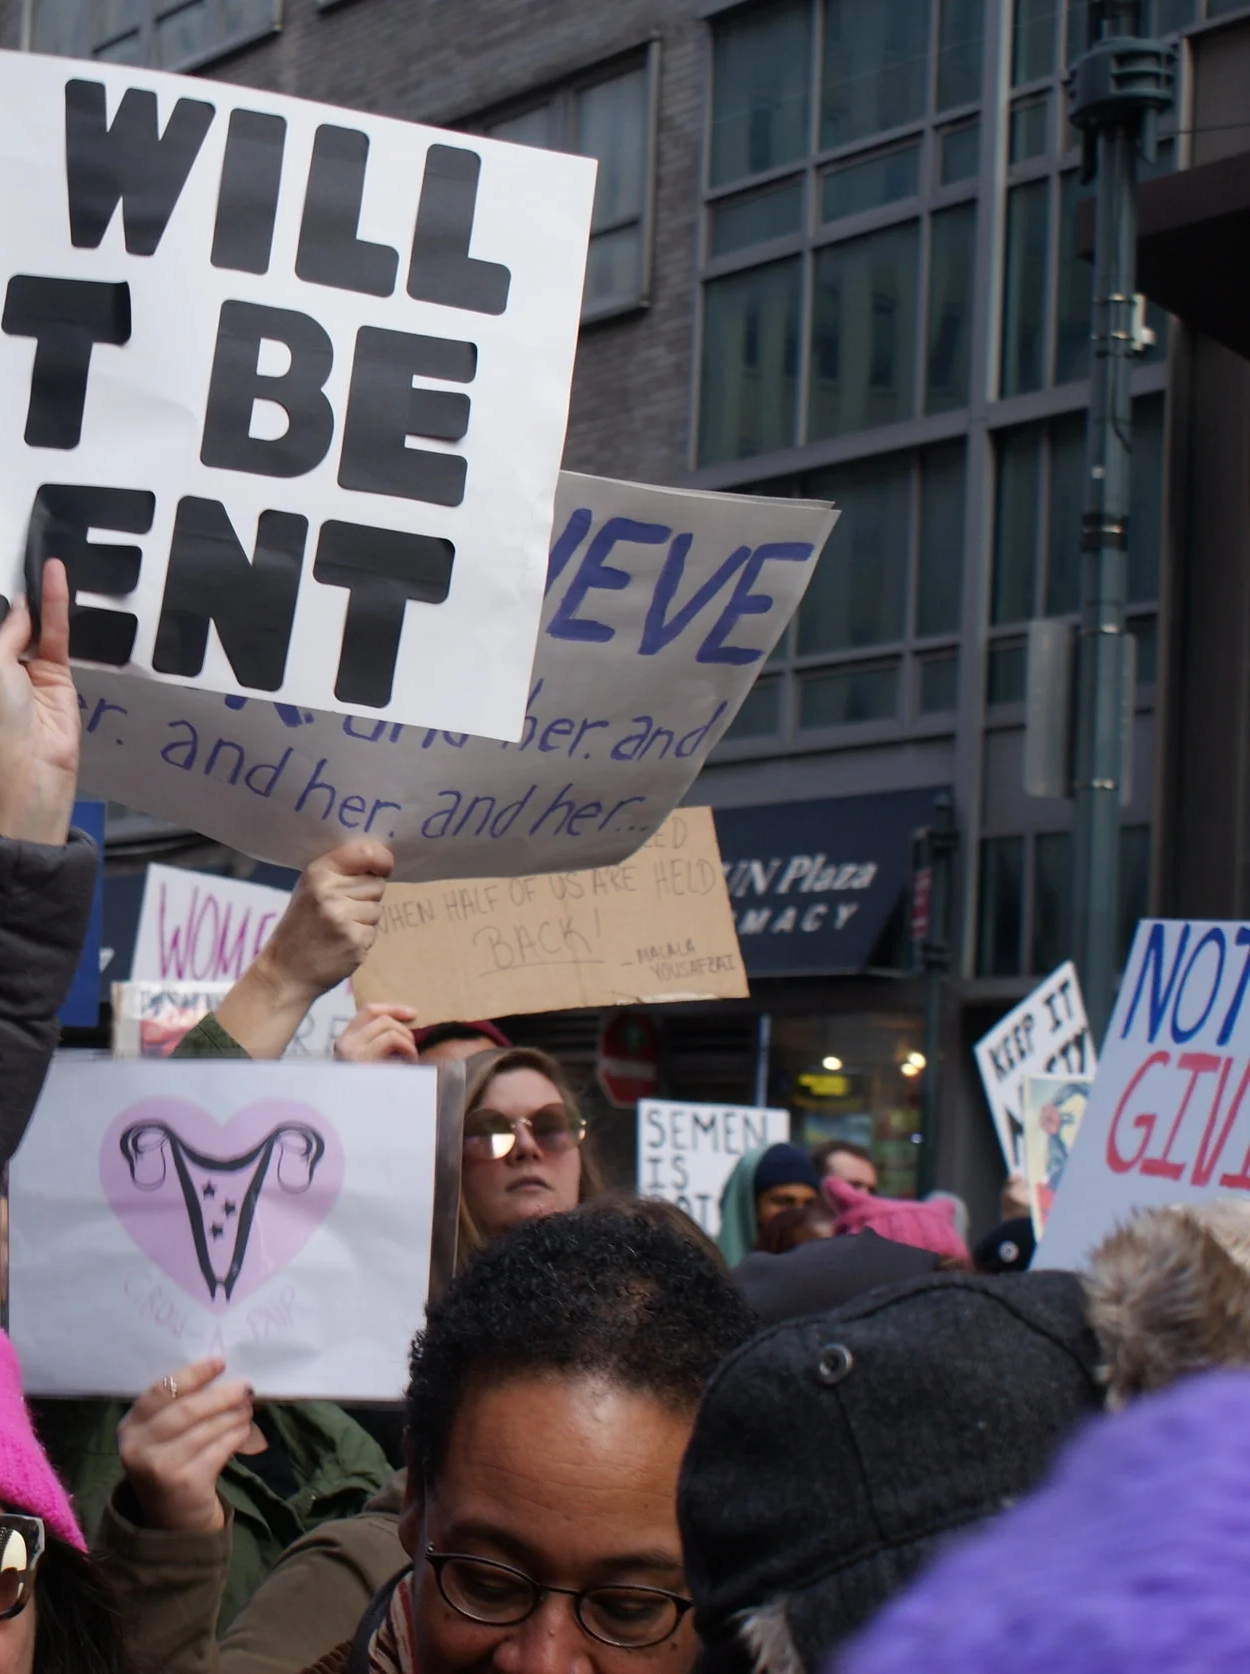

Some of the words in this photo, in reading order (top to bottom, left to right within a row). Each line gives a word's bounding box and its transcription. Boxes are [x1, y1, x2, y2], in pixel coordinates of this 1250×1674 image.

[64, 78, 511, 316] WILL
[199, 299, 478, 507] BE
[545, 507, 815, 666] IEVE
[609, 700, 728, 763] and
[160, 720, 294, 798] and
[294, 757, 402, 838] her.
[421, 783, 538, 839] and
[445, 883, 500, 923] HALF
[508, 875, 538, 908] OF
[592, 864, 639, 897] ARE
[653, 858, 717, 899] HELD
[776, 853, 878, 894] Plaza
[158, 881, 279, 981] WOME
[733, 901, 859, 935] MACY
[988, 1012, 1035, 1084] KEEP
[1042, 977, 1072, 1034] IT
[646, 1109, 769, 1155] SEMEN
[646, 1154, 690, 1191] IS
